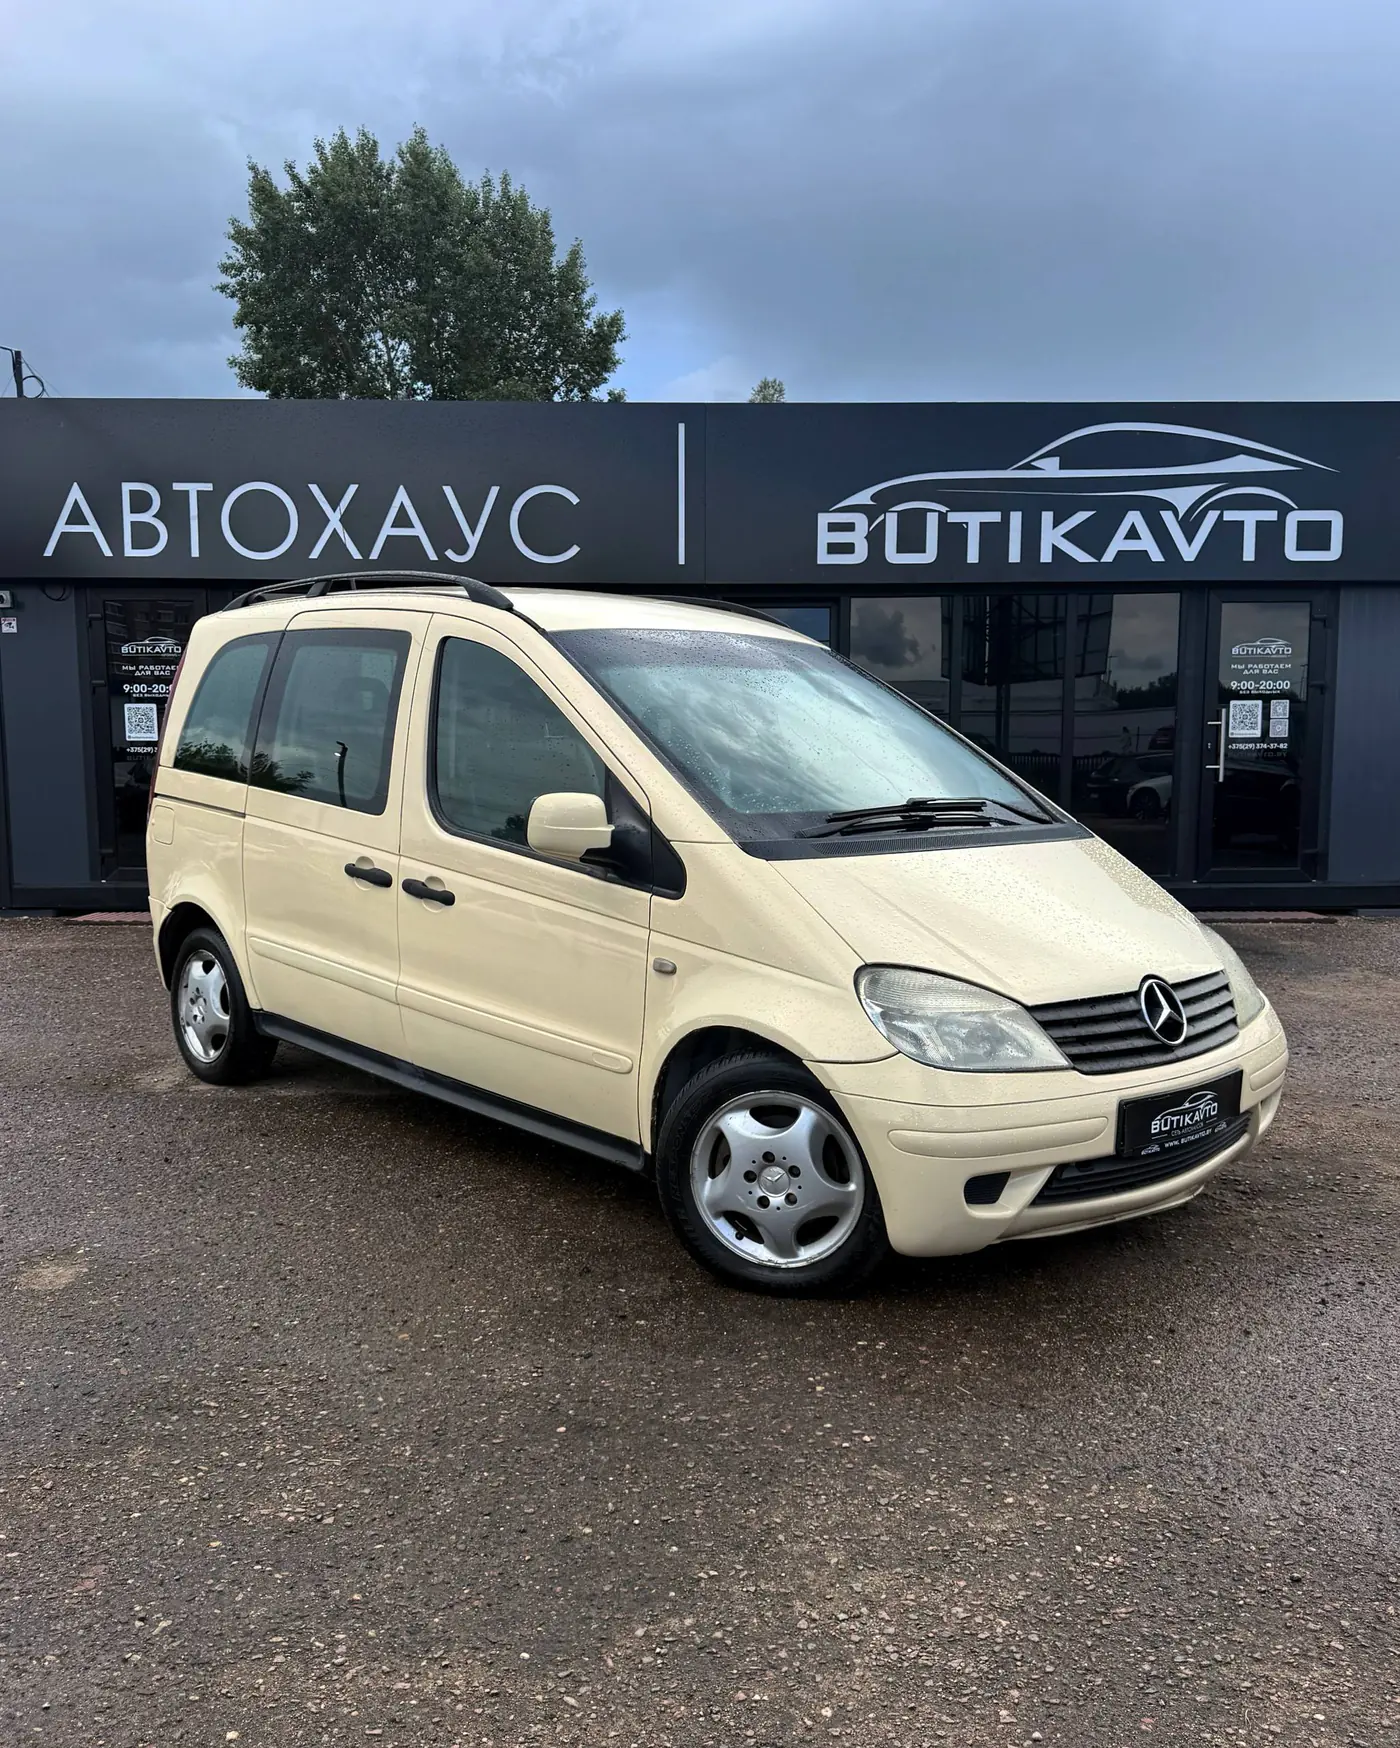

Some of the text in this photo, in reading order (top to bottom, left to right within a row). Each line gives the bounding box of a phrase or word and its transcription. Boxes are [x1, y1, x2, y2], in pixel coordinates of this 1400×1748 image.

[43, 480, 581, 564] АВТОХАУС
[817, 509, 1344, 565] BUTIKAVTO
[121, 645, 181, 654] BUTIKAVTO
[1232, 647, 1292, 655] BUTIKAVTO
[1230, 680, 1291, 690] 9:00-20:00
[126, 746, 154, 754] +375(29)
[1151, 1102, 1218, 1134] BUTIKAVTO
